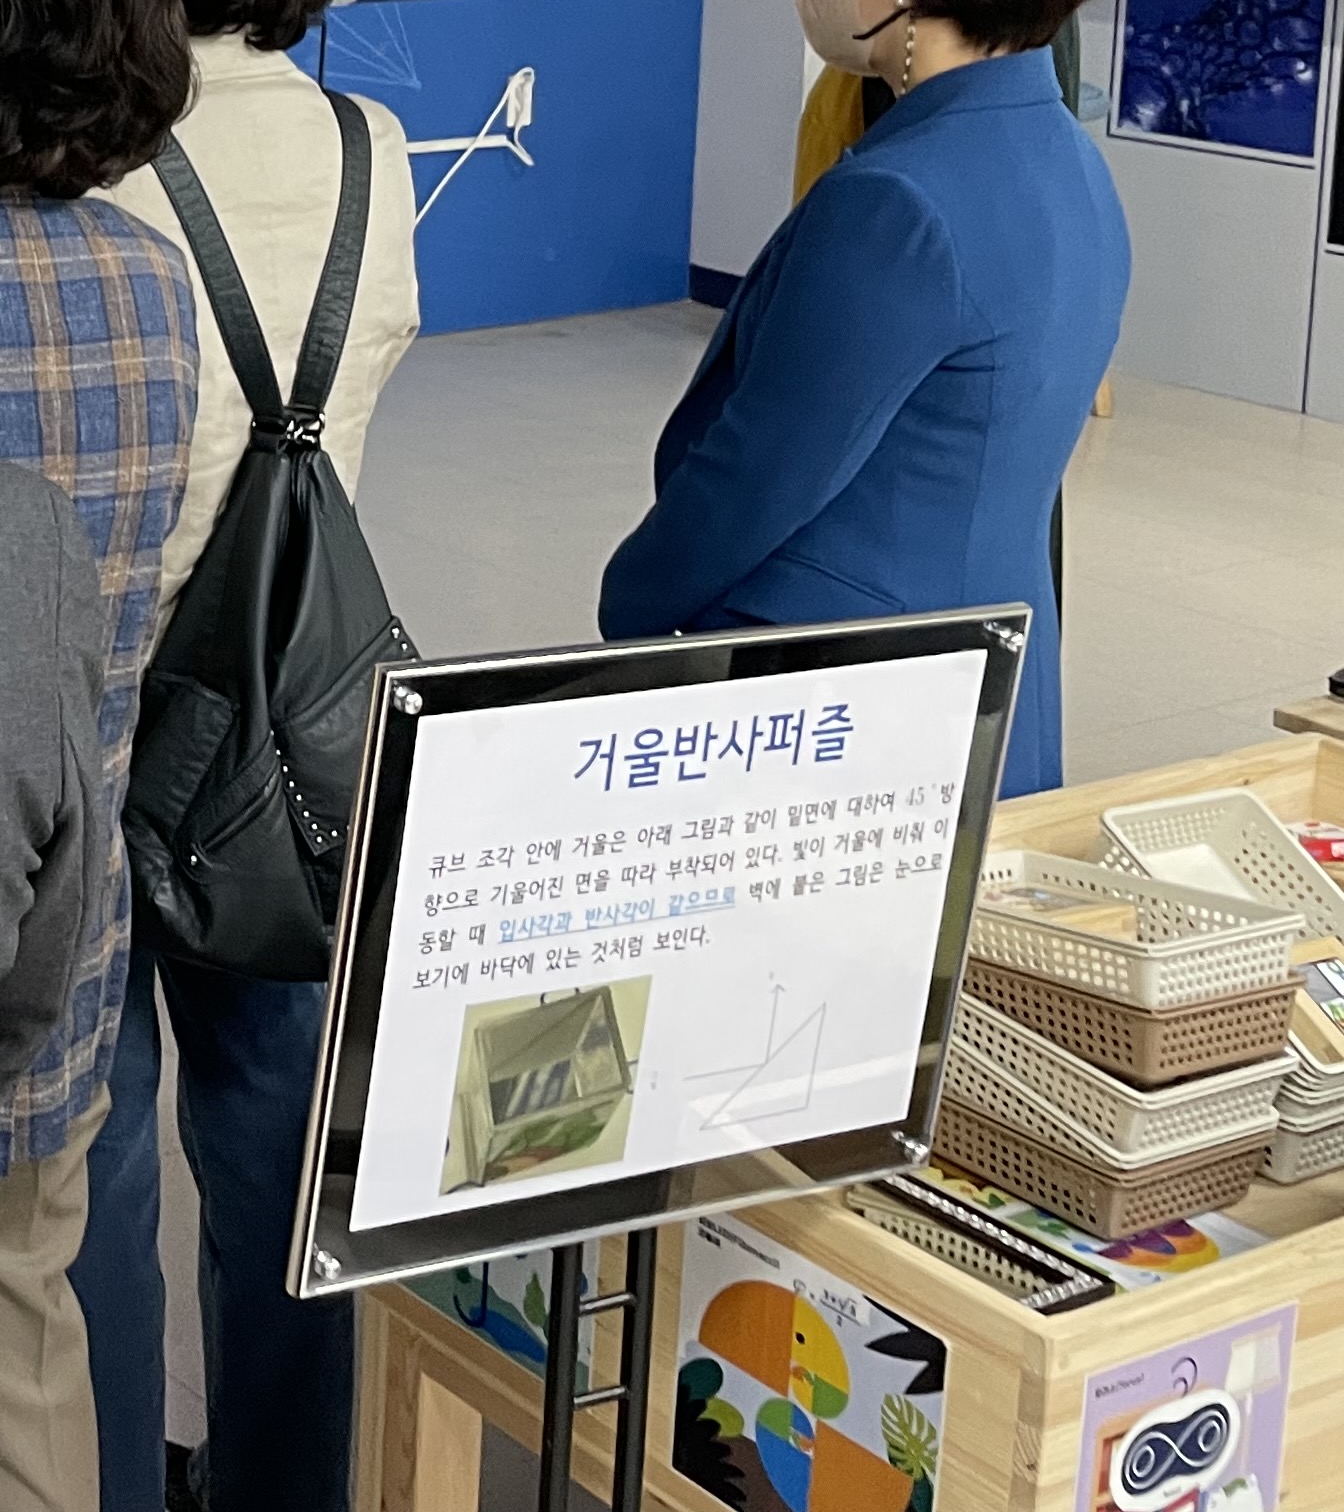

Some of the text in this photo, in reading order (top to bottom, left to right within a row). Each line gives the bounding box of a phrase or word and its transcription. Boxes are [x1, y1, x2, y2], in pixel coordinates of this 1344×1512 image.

[573, 703, 854, 792] 거울반사퍼즐
[424, 888, 480, 917] 향으로
[490, 875, 564, 906] 기울어진
[575, 868, 611, 895] 면을
[621, 863, 657, 888] 따라
[665, 850, 736, 880] 부착되어
[744, 843, 783, 870] 있다.
[834, 827, 884, 854] 거울에
[934, 817, 949, 839] 이
[429, 853, 466, 879] 큐브
[477, 846, 515, 869] 조각
[526, 839, 562, 865] 안에
[571, 830, 627, 857] 거울은
[637, 823, 673, 848] 아래
[681, 814, 735, 840] 그림과
[744, 807, 777, 834] 같이
[788, 798, 838, 827] 밑면에
[847, 790, 895, 817] 대하여
[418, 927, 457, 955] 동할
[469, 923, 487, 946] 때
[499, 912, 573, 943] 입사각과
[584, 897, 656, 928] 반사각이
[749, 877, 781, 902] 벽에
[835, 861, 885, 887] 그림은
[894, 853, 944, 880] 눈으로
[413, 923, 711, 989] 보기에 바닥에 있는 것처럼 보인다.
